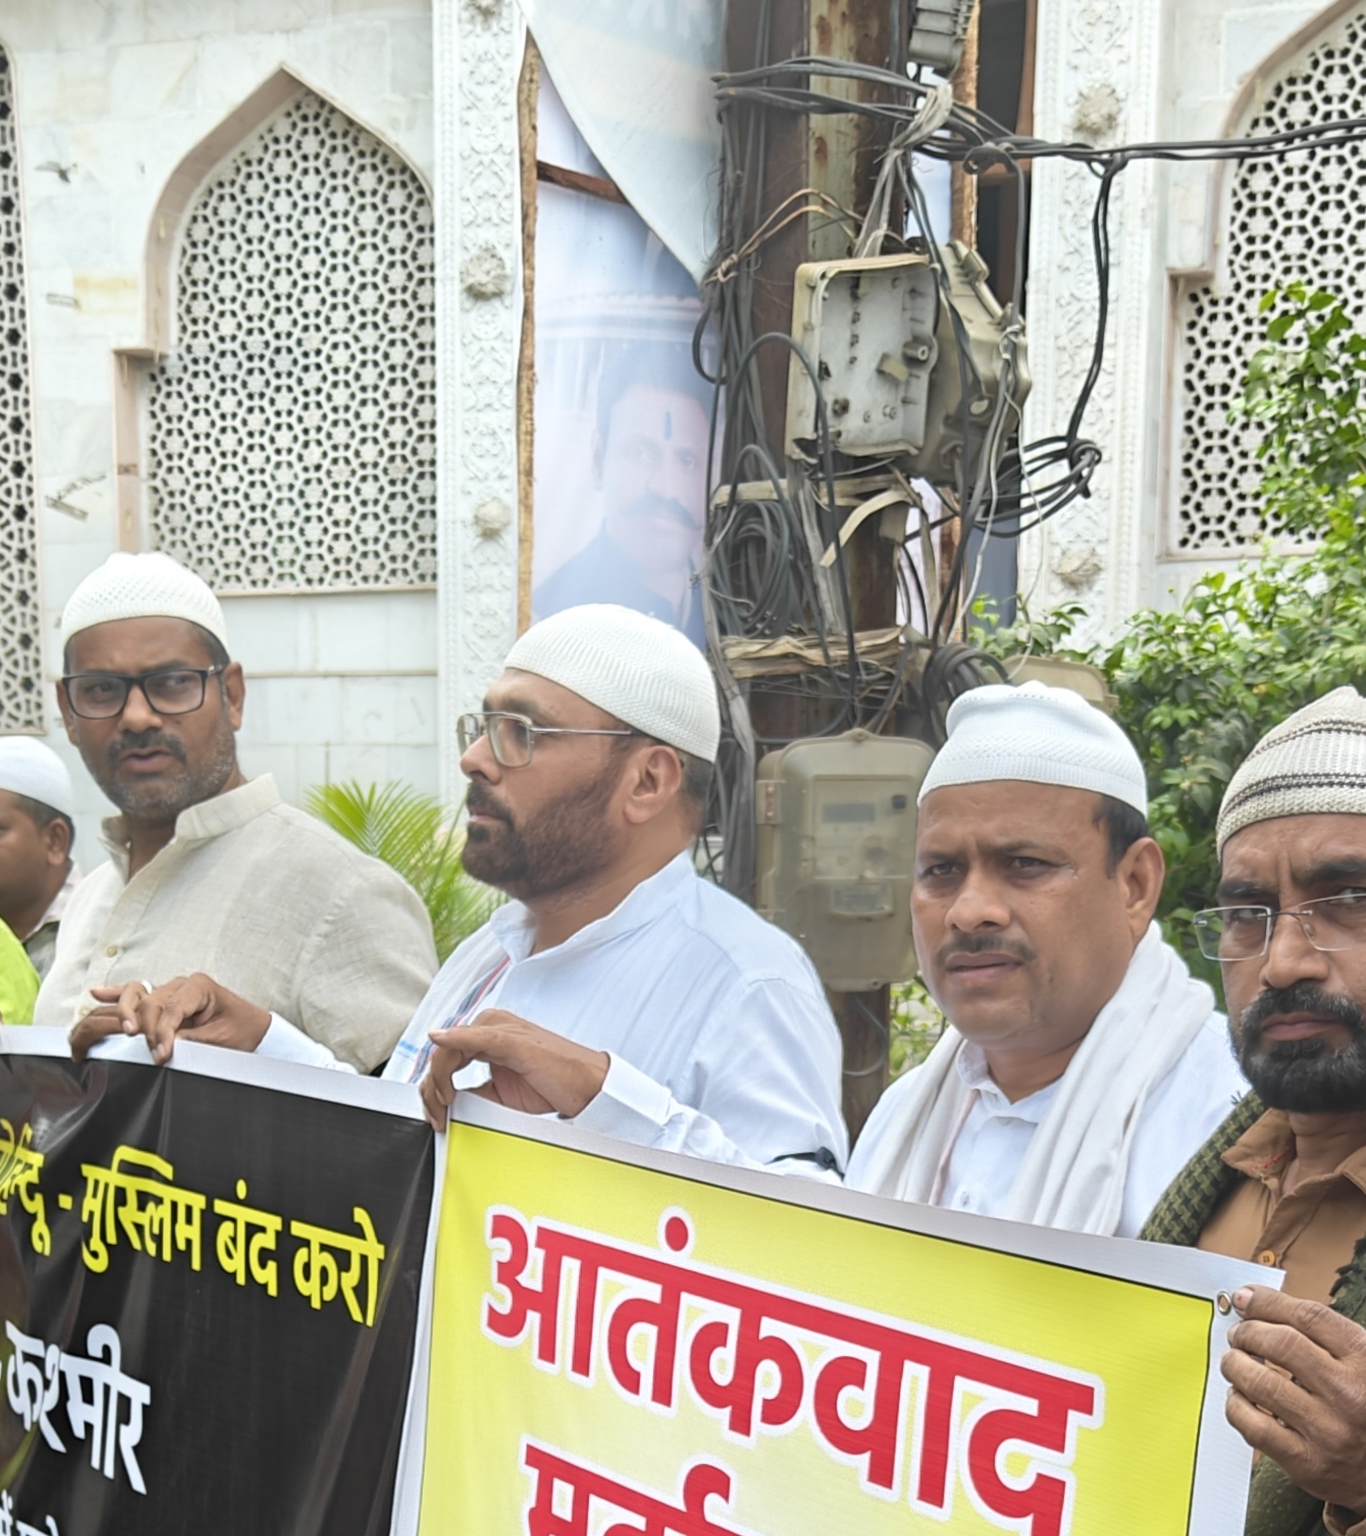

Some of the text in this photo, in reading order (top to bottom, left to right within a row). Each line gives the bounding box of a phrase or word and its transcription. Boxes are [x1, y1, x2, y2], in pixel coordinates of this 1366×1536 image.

[81, 1145, 206, 1273] मुस्लिम
[214, 1179, 283, 1297] बंद
[290, 1207, 385, 1326] करो
[5, 1321, 151, 1495] कश्मीर
